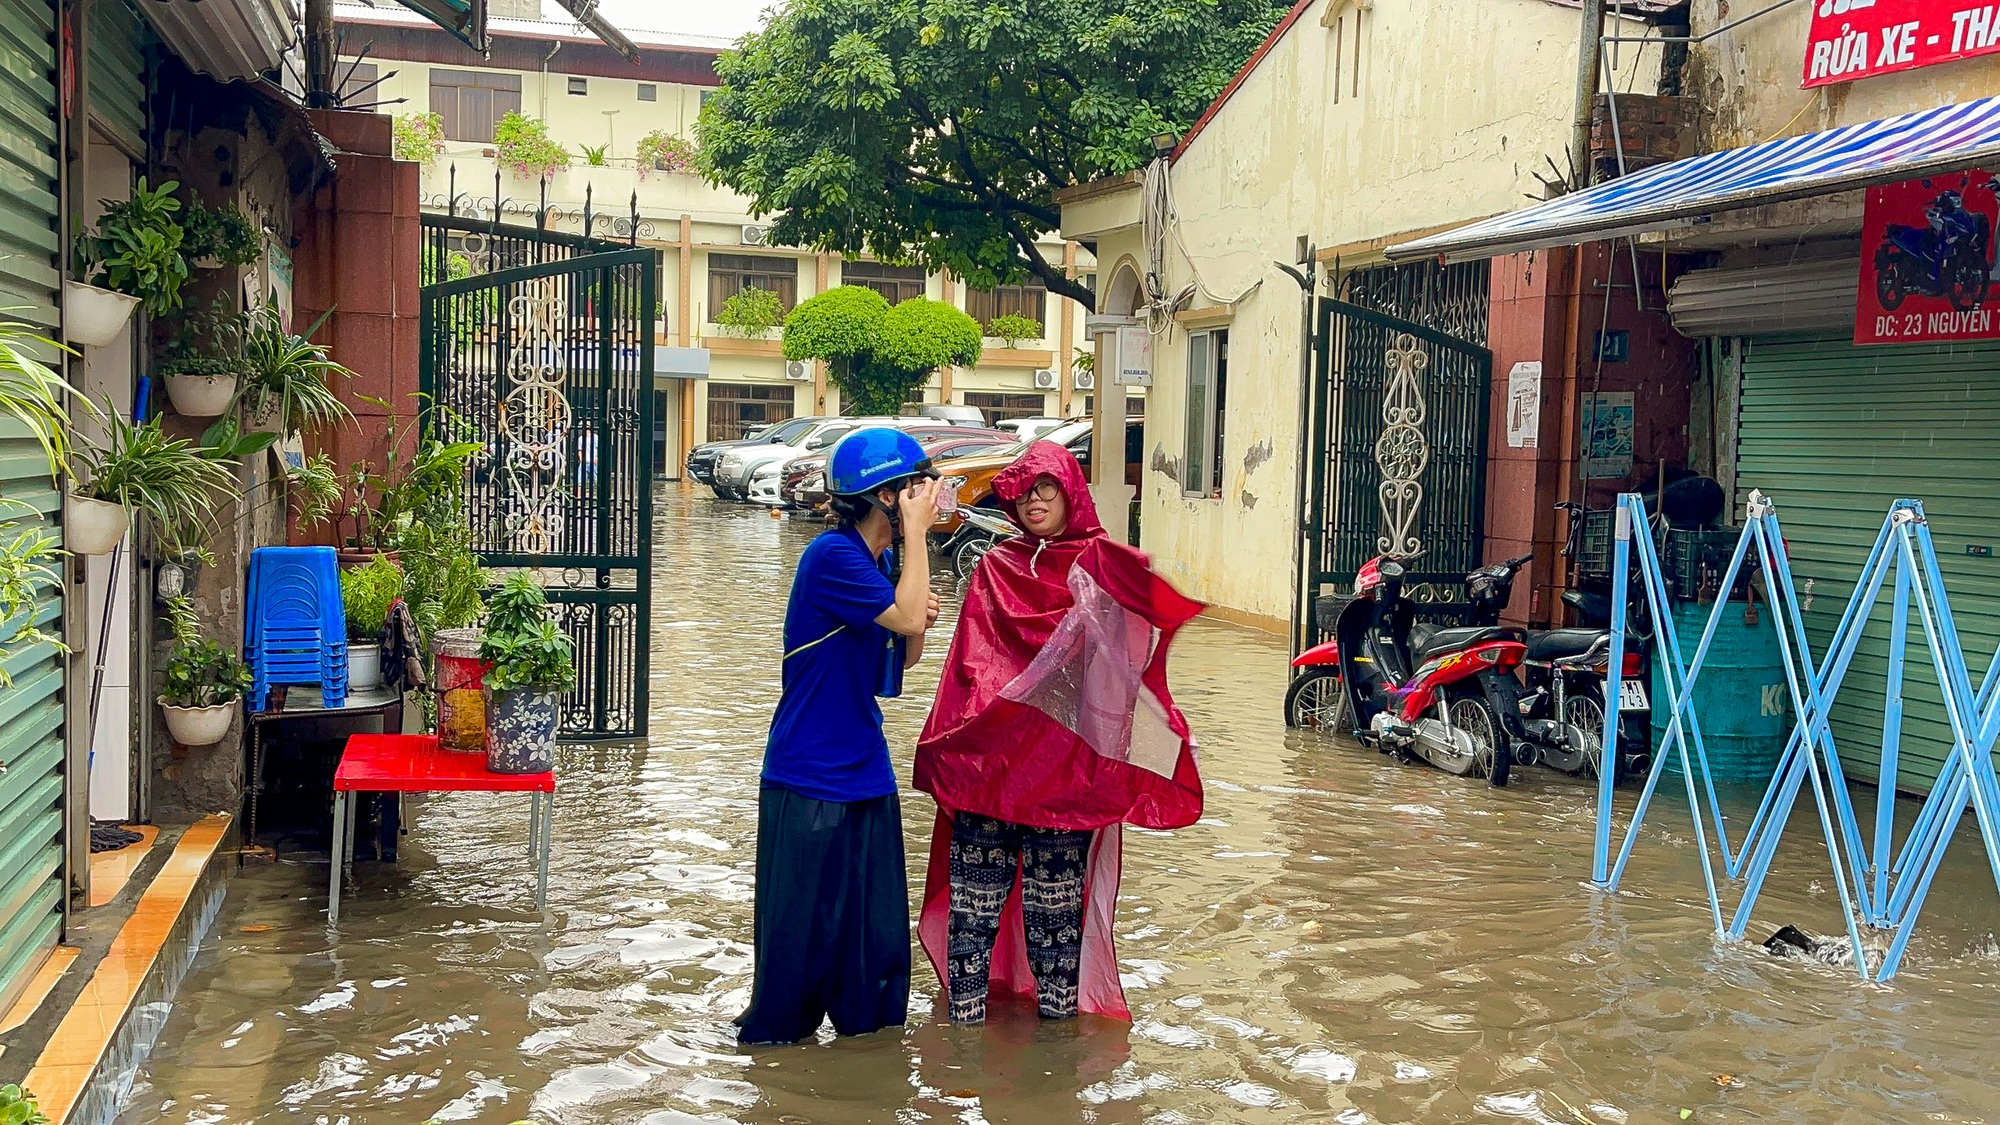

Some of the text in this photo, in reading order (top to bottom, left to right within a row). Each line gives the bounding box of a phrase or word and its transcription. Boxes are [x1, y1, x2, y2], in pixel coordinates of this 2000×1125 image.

[1809, 23, 1868, 79] RỬA
[1875, 21, 1920, 67] XE
[1875, 315, 1899, 337] ĐC:
[1903, 313, 1922, 336] 23
[1928, 302, 1991, 334] NGUYỄN
[1619, 695, 1644, 708] 743
